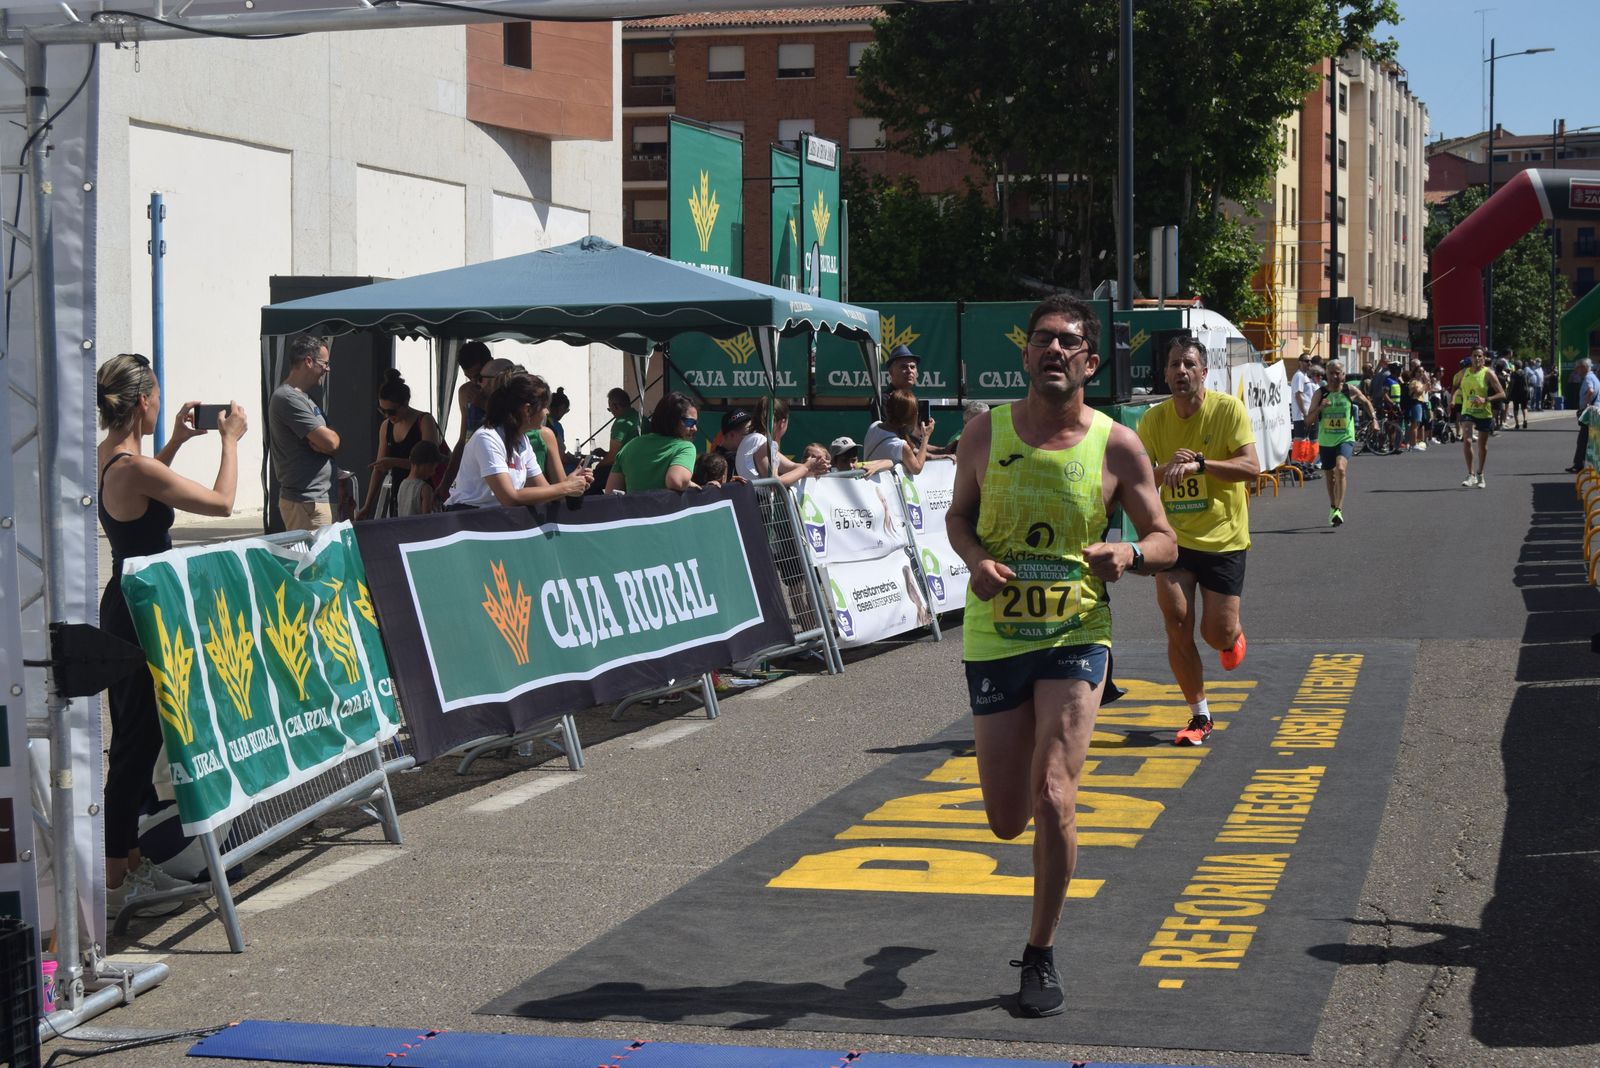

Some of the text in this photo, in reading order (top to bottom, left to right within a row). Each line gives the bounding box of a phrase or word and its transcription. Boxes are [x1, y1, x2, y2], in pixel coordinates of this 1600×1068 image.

[684, 370, 727, 388] CAJA
[880, 371, 946, 388] RAL
[979, 371, 1026, 388] CAJA
[1329, 419, 1341, 427] 44
[1171, 478, 1199, 498] 158
[1018, 572, 1069, 580] CAJA RURAL
[540, 558, 718, 649] CAJA RURAL
[1002, 585, 1072, 618] 207
[1019, 619, 1074, 636] CAJA RUAL
[1139, 853, 1291, 969] REFORMA
[1215, 765, 1327, 844] INTEGRAL
